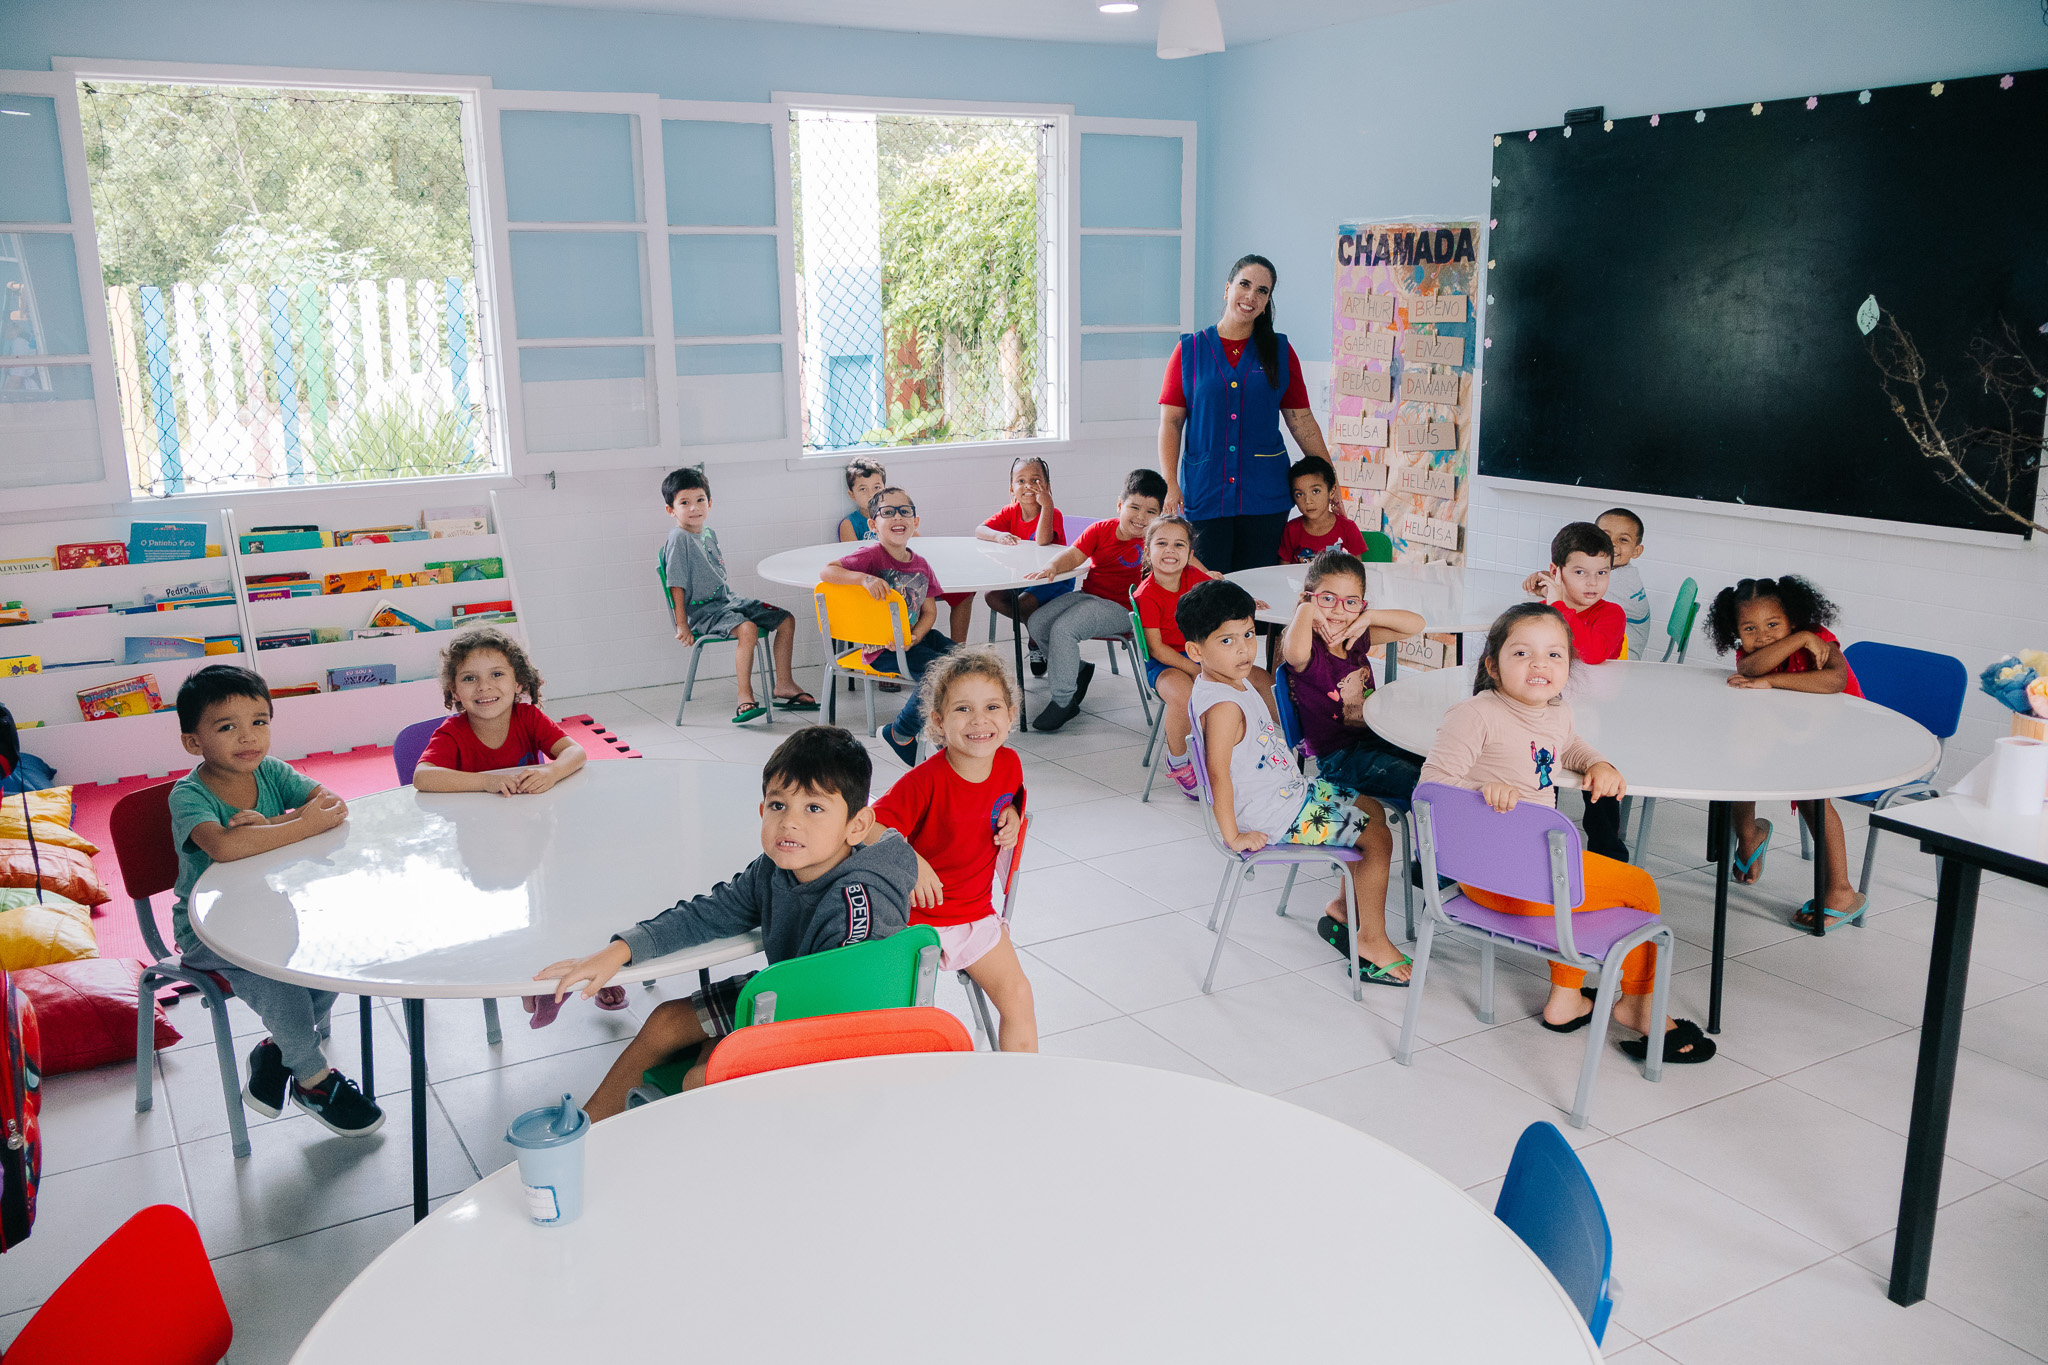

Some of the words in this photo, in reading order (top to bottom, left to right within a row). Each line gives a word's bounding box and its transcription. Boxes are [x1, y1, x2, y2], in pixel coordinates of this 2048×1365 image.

[1338, 228, 1475, 266] CHAMADA
[1344, 296, 1391, 320] ARTHUR
[1415, 300, 1460, 317] BRENO
[1344, 335, 1389, 355] GABRIEL
[1415, 340, 1454, 359] ENZO
[1342, 371, 1381, 393] PEDRO
[1407, 378, 1457, 397] DAWANY
[1335, 423, 1379, 439] HELOISA
[1408, 428, 1440, 445] LUIS
[1343, 466, 1375, 483] LUAN
[1402, 472, 1447, 493] HELENA
[1346, 505, 1377, 527] GATA
[1404, 520, 1452, 544] HELOISA
[148, 540, 177, 548] Patinho
[165, 586, 189, 598] Pedro
